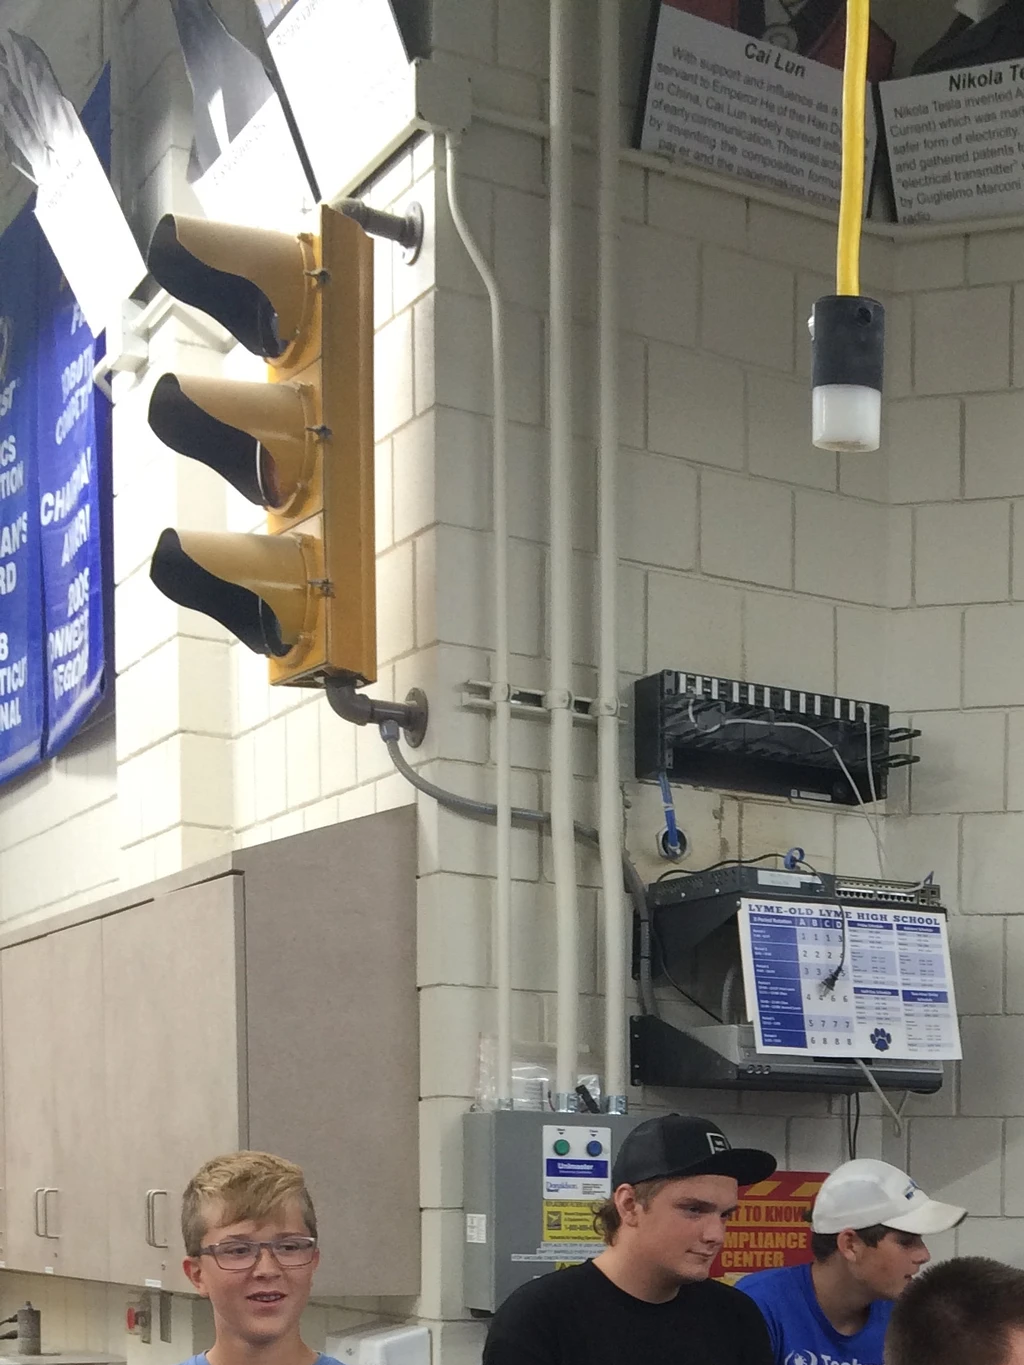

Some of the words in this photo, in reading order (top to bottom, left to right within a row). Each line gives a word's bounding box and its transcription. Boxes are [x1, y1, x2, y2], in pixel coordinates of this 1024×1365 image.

[744, 42, 773, 65] Cai
[773, 52, 807, 78] Lun
[948, 69, 1003, 92] Nikola
[899, 196, 914, 209] by
[916, 188, 974, 206] Guglielmo
[976, 180, 1021, 196] Marconi
[748, 904, 813, 917] LYME-OLD
[820, 909, 853, 919] LYME
[856, 912, 889, 922] HIGH
[893, 914, 941, 926] SCHOOL
[799, 918, 807, 926] A
[812, 919, 820, 927] B
[744, 1205, 761, 1222] TO
[765, 1205, 808, 1222] KNOW
[724, 1231, 807, 1249] MPLIANCE
[721, 1250, 785, 1268] CENTER
